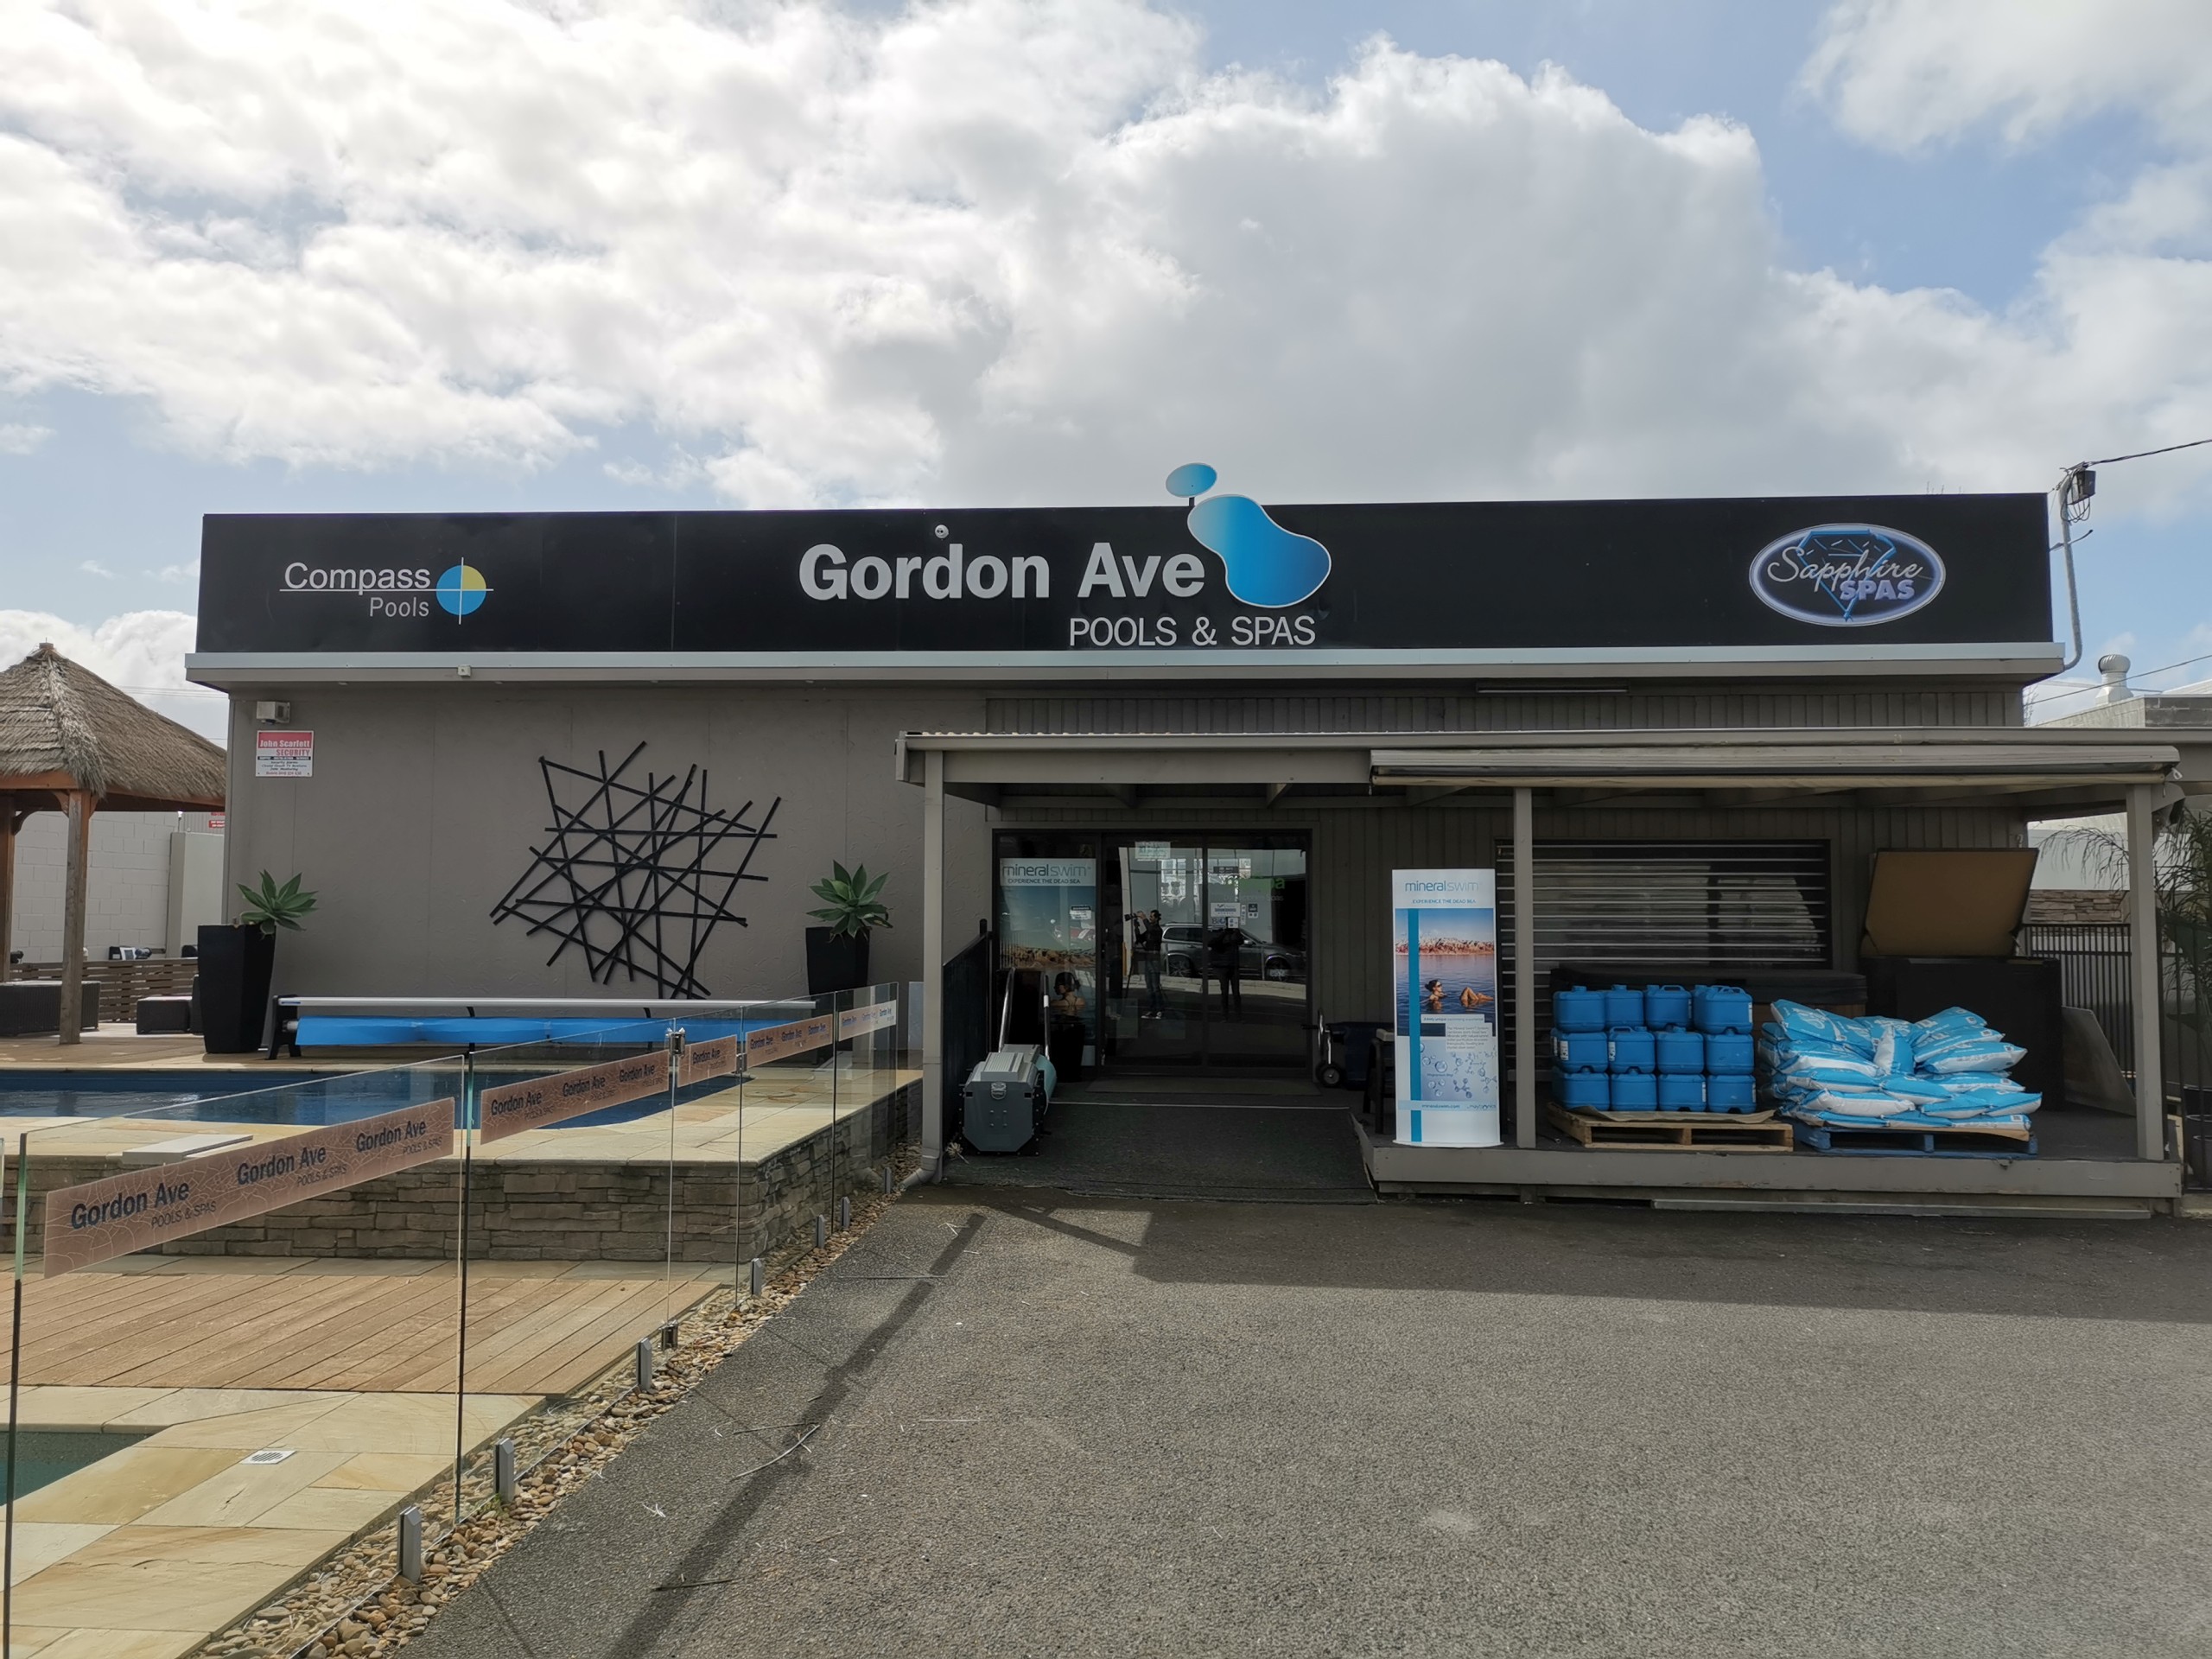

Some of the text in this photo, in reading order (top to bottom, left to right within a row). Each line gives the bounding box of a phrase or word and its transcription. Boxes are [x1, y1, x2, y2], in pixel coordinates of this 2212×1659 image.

[284, 562, 431, 596] Compass
[798, 542, 1205, 602] Gordon Ave
[1767, 546, 1923, 592] Sapphire
[1840, 579, 1916, 601] SPAS
[369, 596, 430, 619] Pools
[1070, 614, 1317, 647] POOLS & SPAS
[1405, 880, 1479, 892] mineralswim
[563, 1079, 590, 1097] Gordon
[592, 1076, 606, 1089] Ave
[619, 1065, 642, 1083] Gordon
[643, 1063, 656, 1075] Ave
[491, 1096, 524, 1116] Gordon
[526, 1091, 543, 1107] Ave
[356, 1120, 427, 1153] Gordon Ave
[237, 1147, 327, 1185] Gordon Ave
[296, 1170, 321, 1187] POOLS
[330, 1163, 347, 1179] SPAS
[72, 1182, 190, 1230] Gordon Ave
[151, 1201, 218, 1230] POOLS & SPAS
